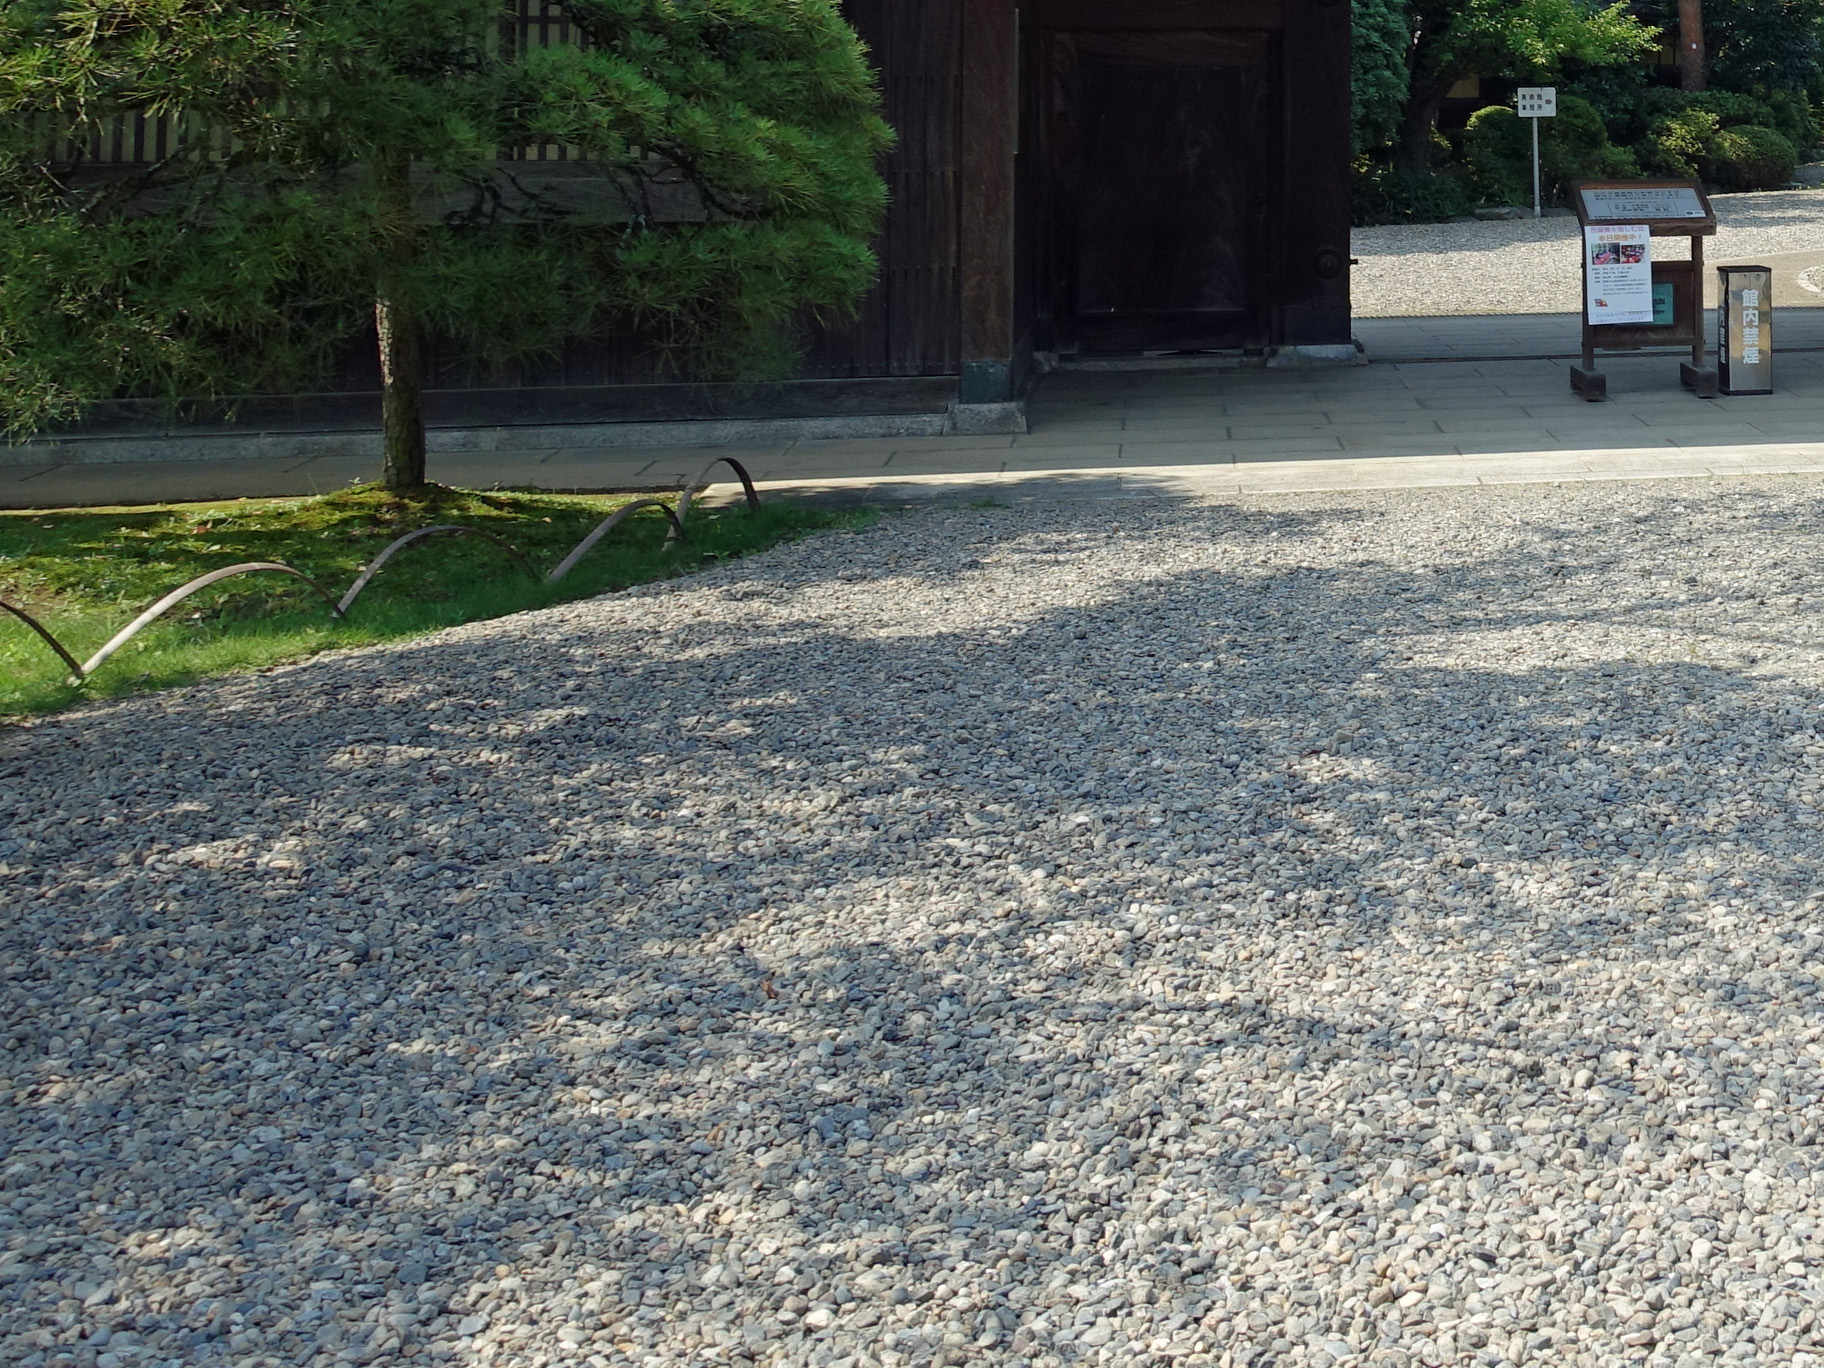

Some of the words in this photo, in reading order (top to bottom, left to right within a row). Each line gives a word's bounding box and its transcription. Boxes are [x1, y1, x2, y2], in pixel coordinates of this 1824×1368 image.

[1521, 93, 1543, 101] 美術館
[1521, 103, 1543, 111] 事務所
[1742, 288, 1760, 365] 館内禁煙
